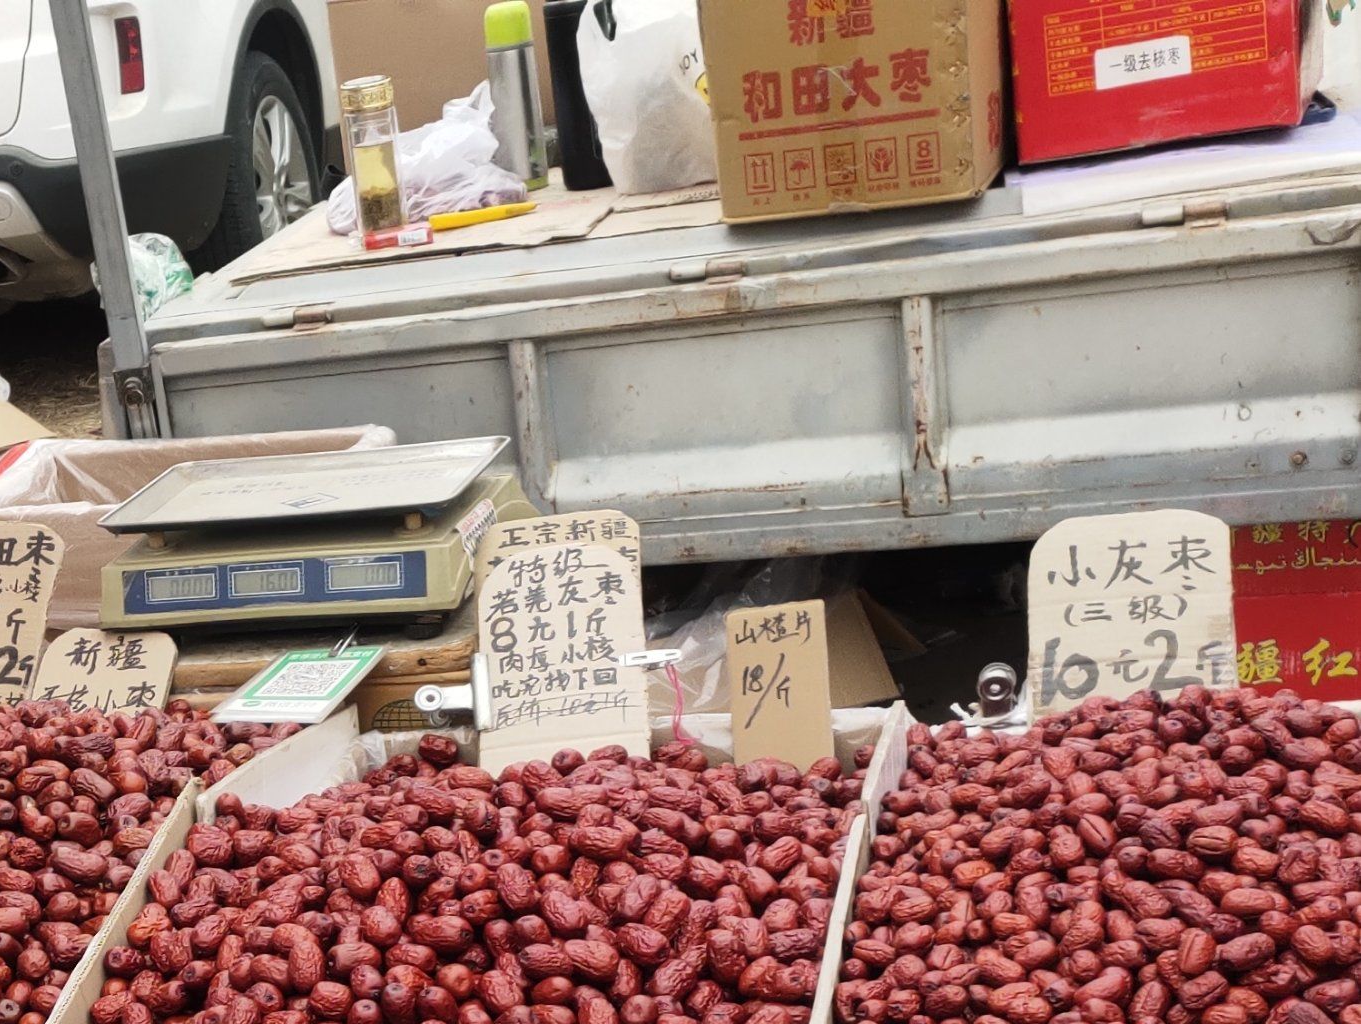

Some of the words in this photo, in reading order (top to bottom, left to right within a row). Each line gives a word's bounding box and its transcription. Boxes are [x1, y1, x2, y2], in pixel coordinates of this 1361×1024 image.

[742, 48, 932, 122] 和田大枣
[499, 518, 628, 548] 正宗新疆
[508, 548, 609, 587] 特级
[1048, 535, 1216, 591] 小灰枣
[490, 607, 608, 652] 8元1斤
[735, 610, 811, 645] 山楂片
[65, 637, 148, 675] 新疆
